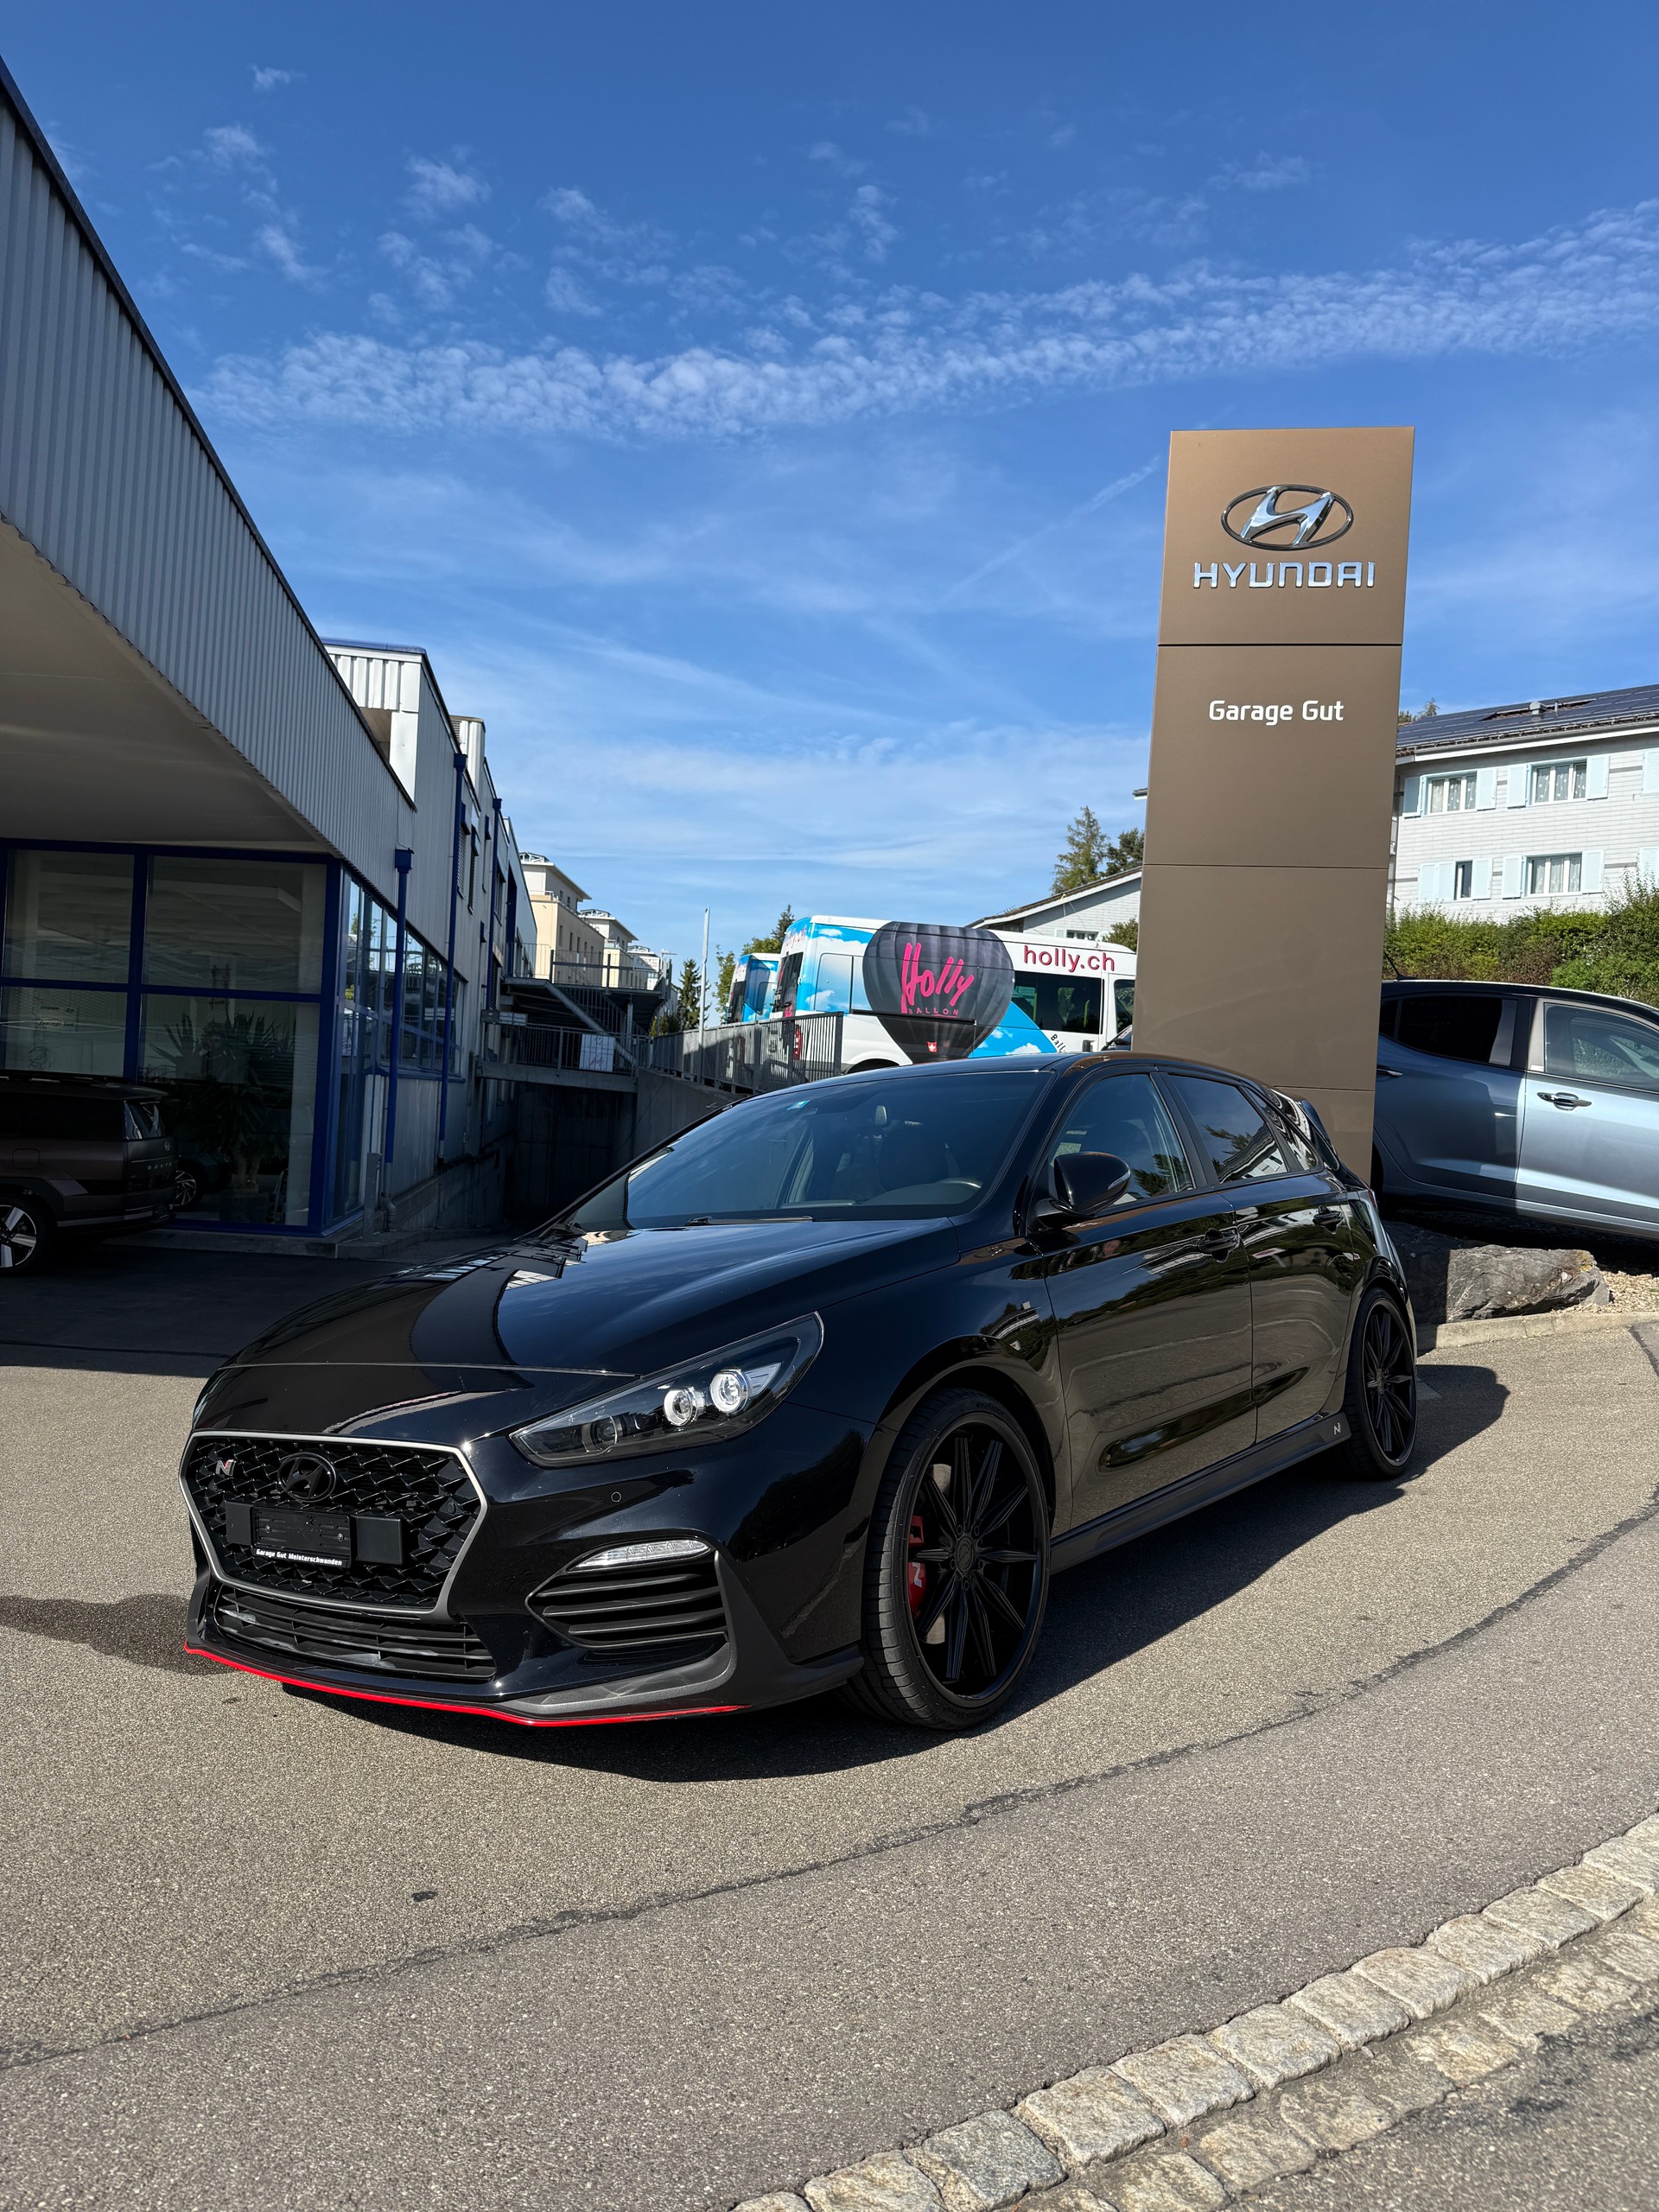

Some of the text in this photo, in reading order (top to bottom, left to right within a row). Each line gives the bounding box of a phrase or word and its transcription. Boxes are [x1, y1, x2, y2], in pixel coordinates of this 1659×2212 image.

[1192, 562, 1376, 588] HYUNDAI
[1208, 700, 1344, 726] Garage Gut
[1024, 944, 1115, 973] holly.ch
[901, 942, 975, 1014] Holly
[907, 1007, 959, 1016] BALLON
[1050, 1033, 1066, 1052] Ball
[1333, 1422, 1341, 1435] N
[215, 1459, 234, 1477] N
[256, 1548, 276, 1558] Garage
[288, 1553, 343, 1567] Meisterschwanden
